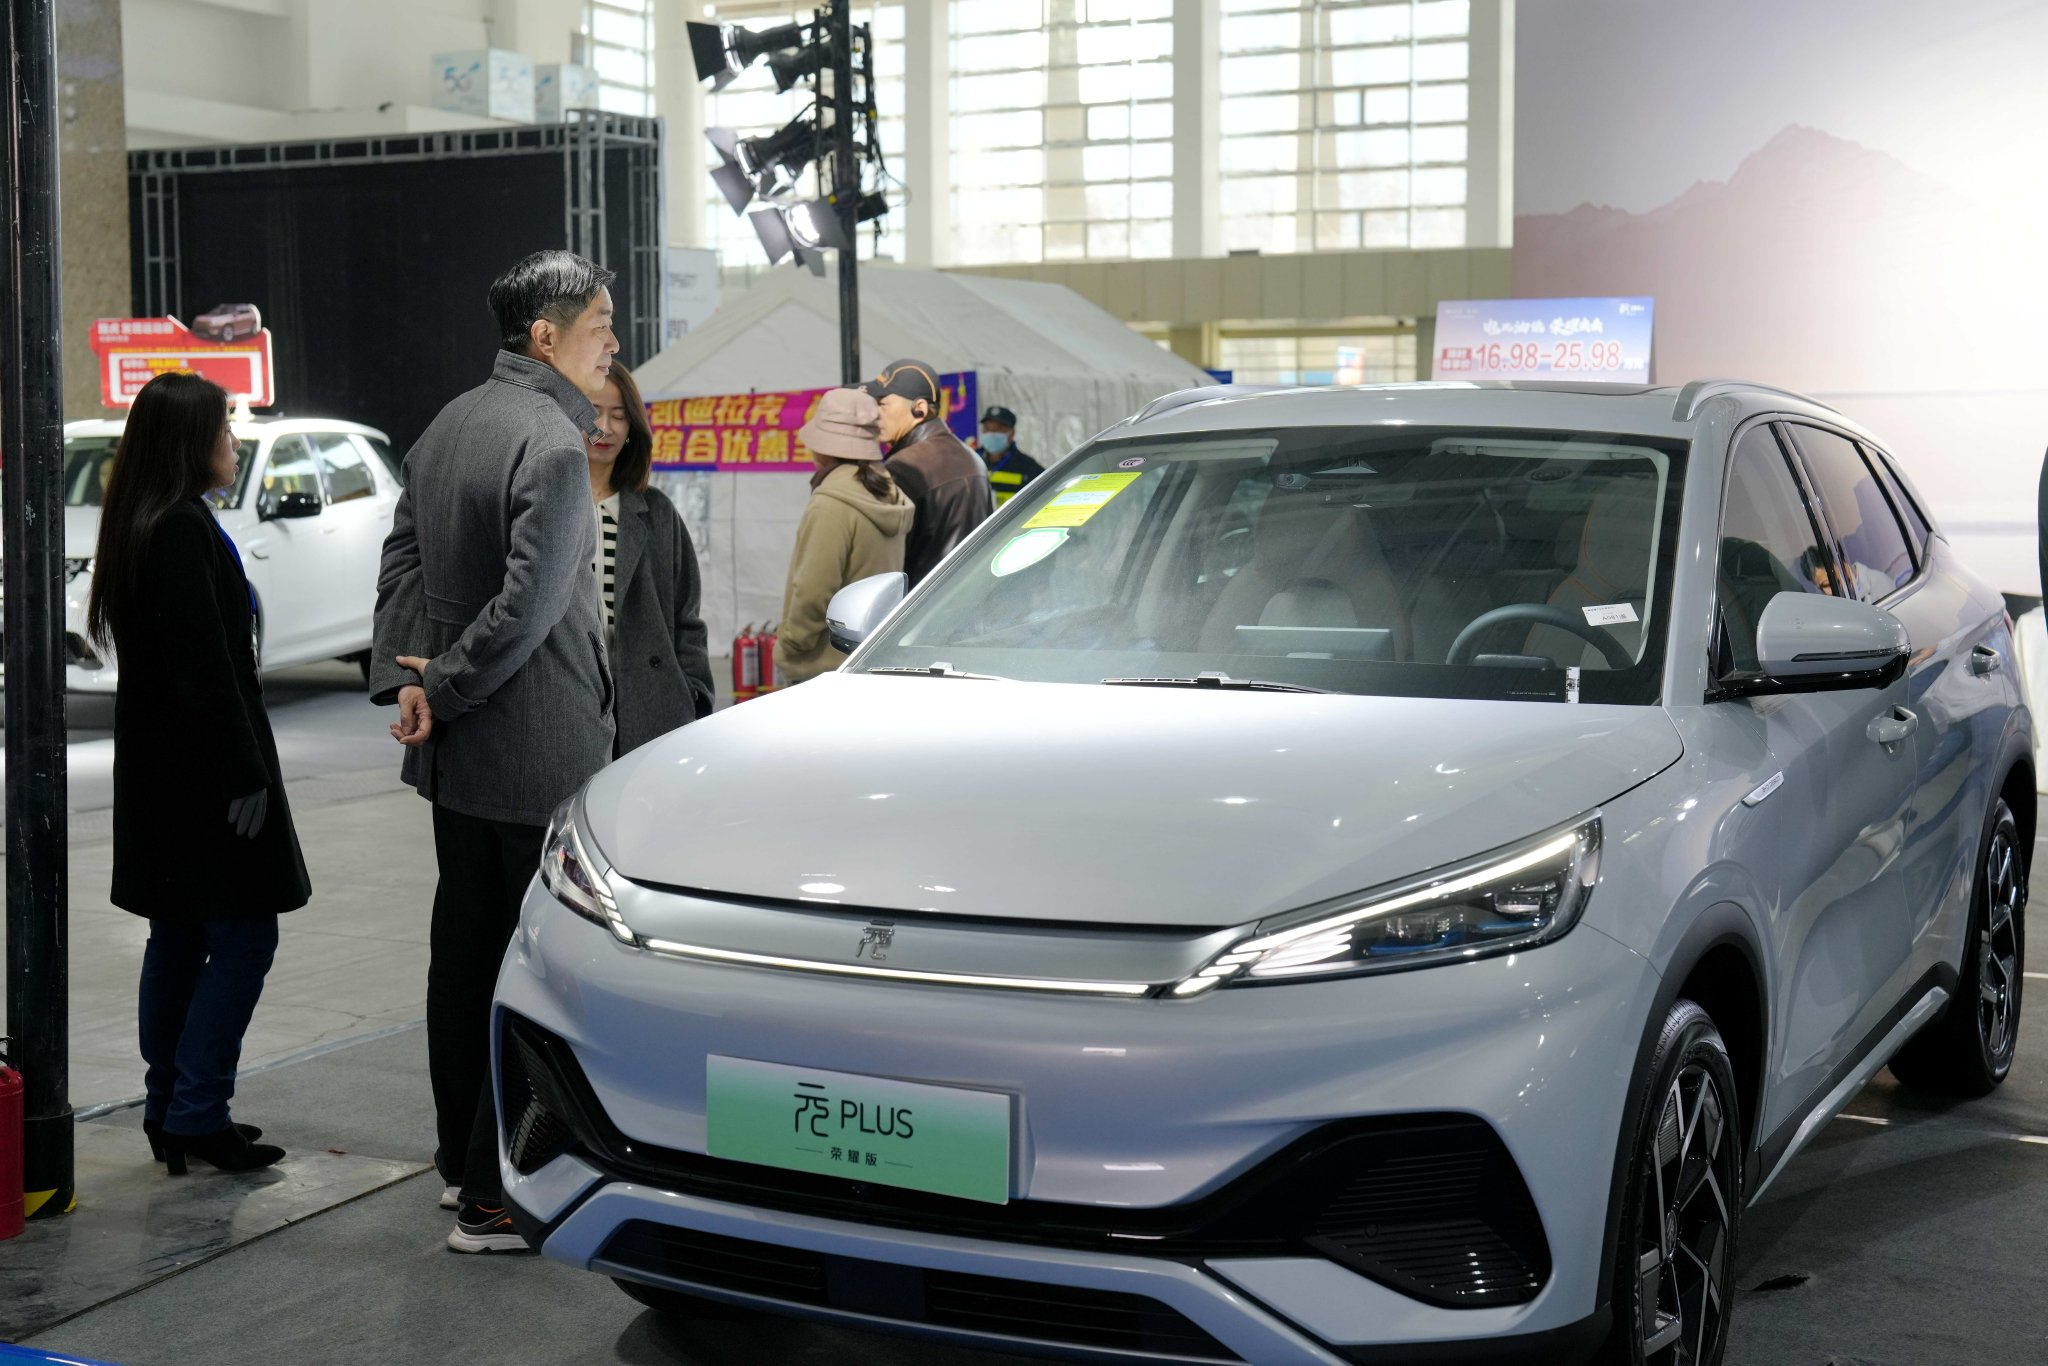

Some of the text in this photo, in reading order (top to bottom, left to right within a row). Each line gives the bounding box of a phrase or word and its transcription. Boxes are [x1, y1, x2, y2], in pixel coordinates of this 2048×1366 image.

[1476, 342, 1620, 370] 16.98-25.98
[650, 395, 787, 427] 凯迪拉克
[794, 1082, 914, 1139] 元 PLUS
[830, 1147, 878, 1167] 荣耀版
